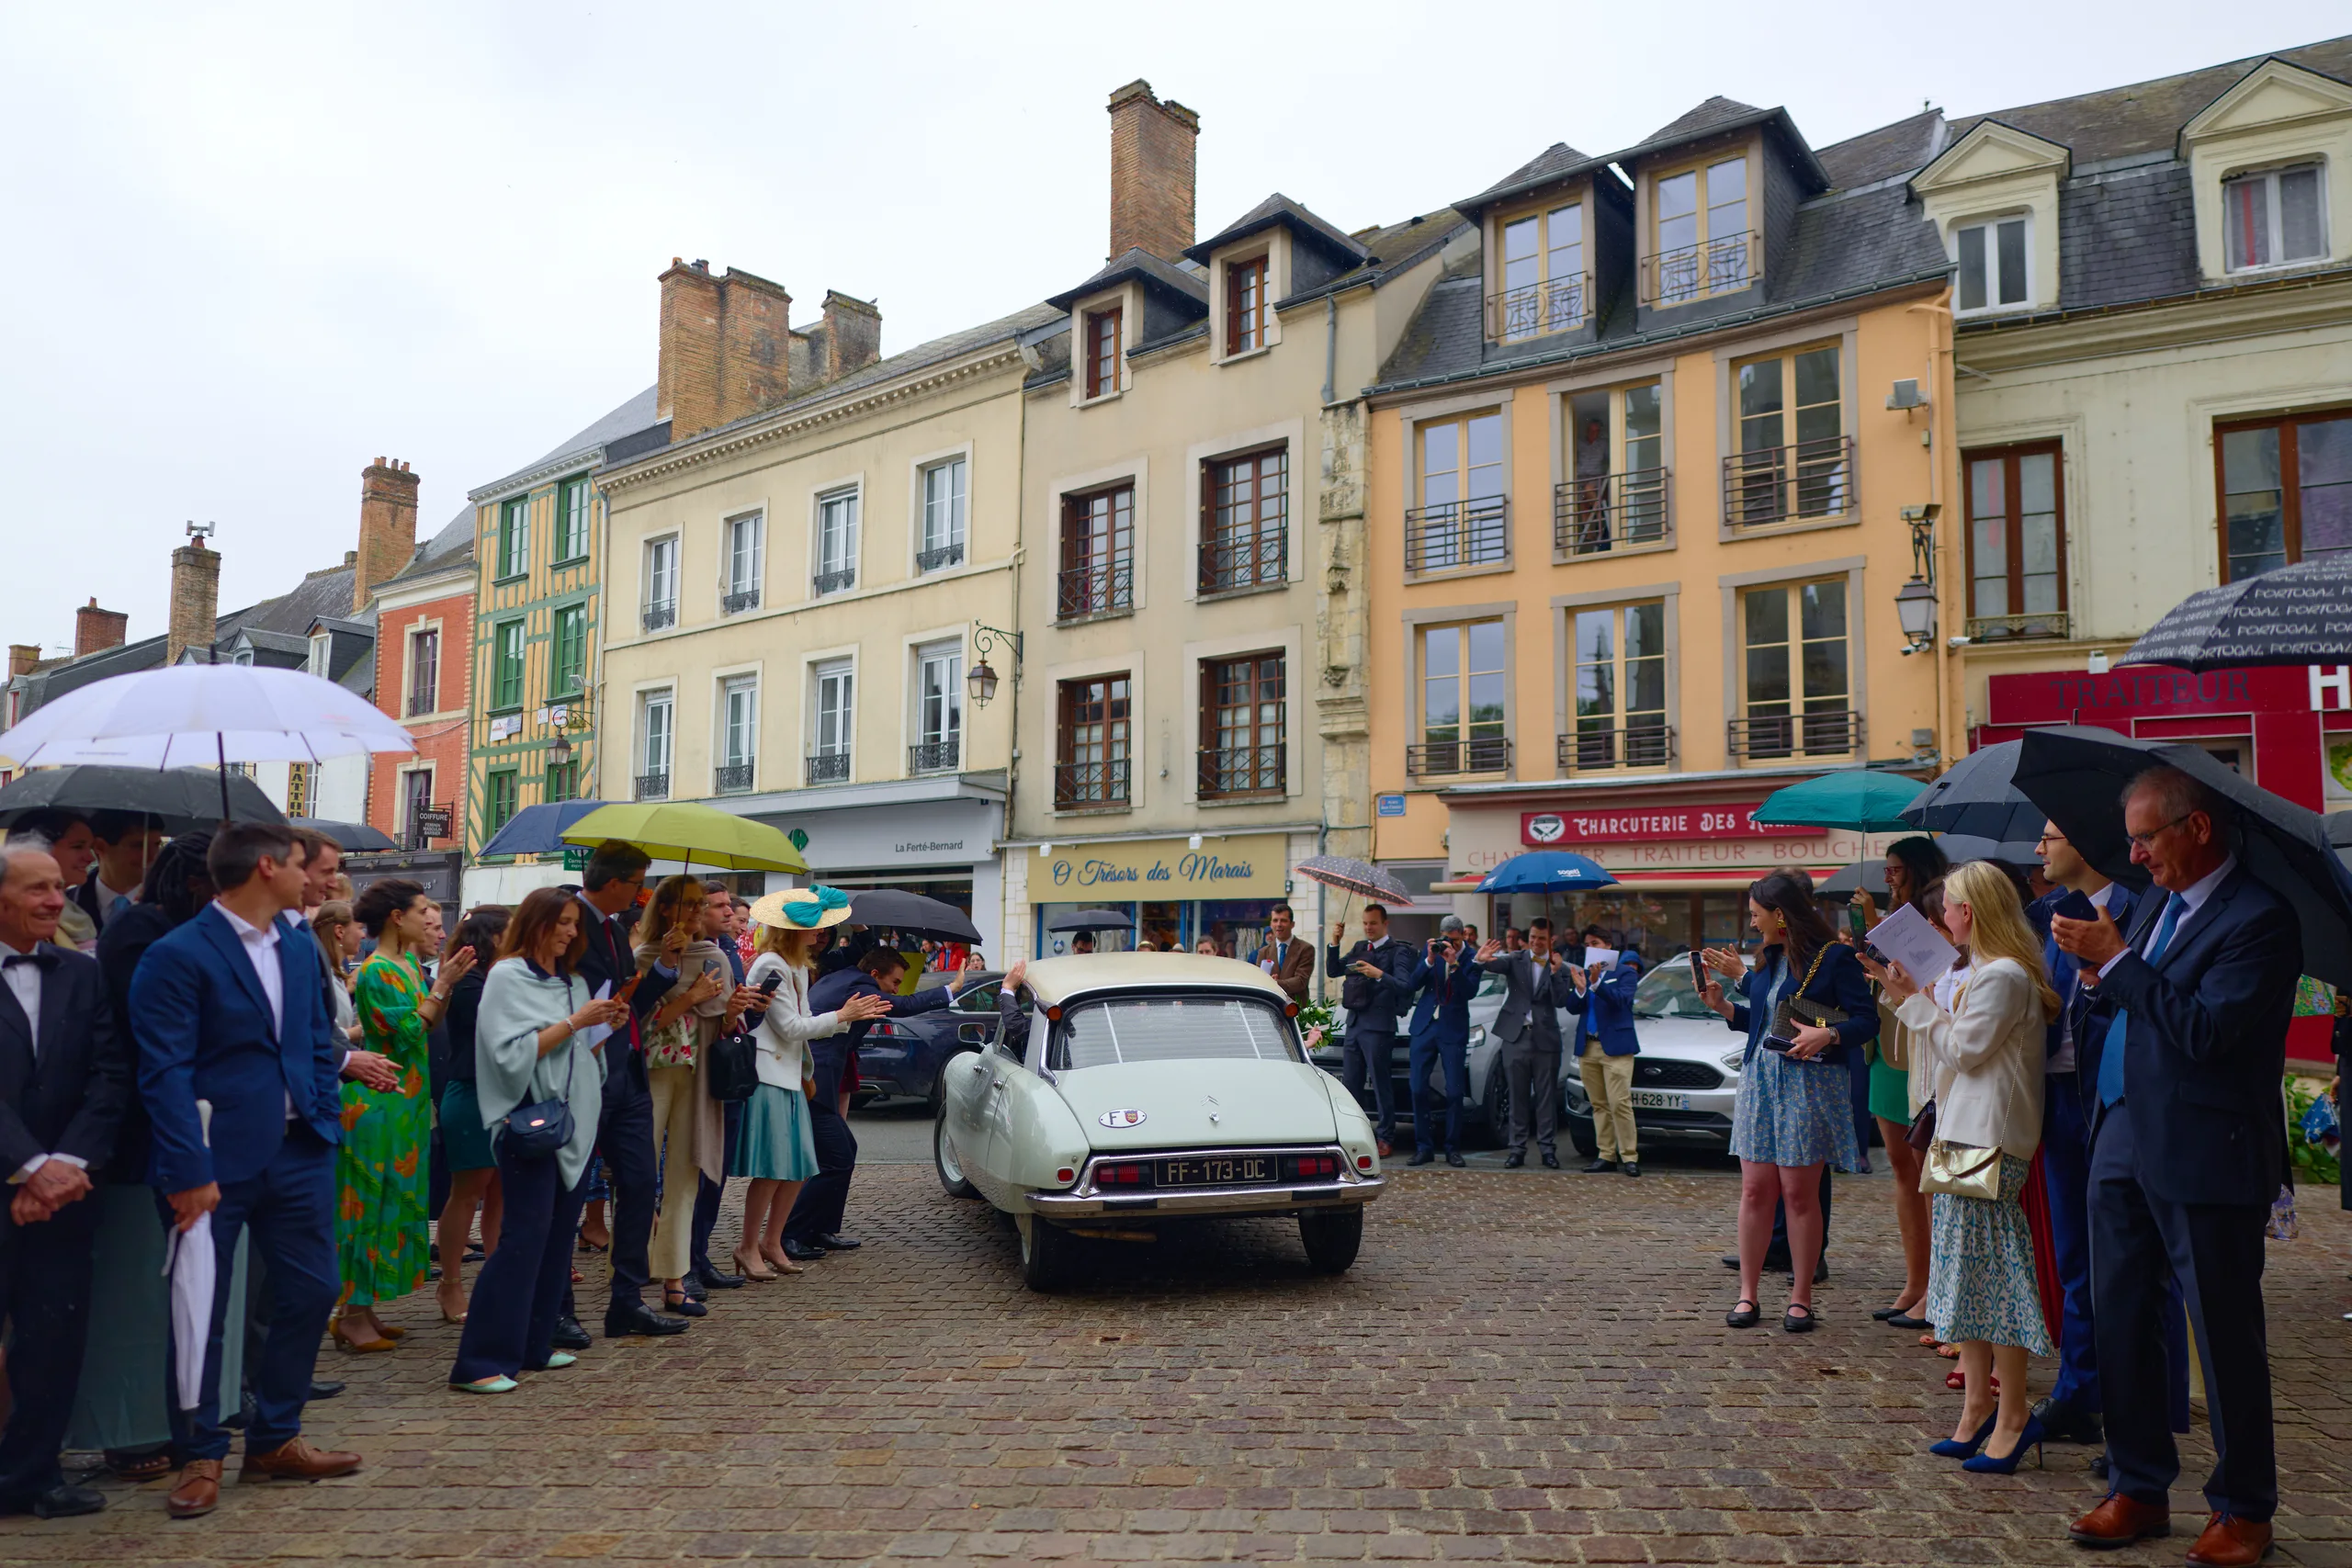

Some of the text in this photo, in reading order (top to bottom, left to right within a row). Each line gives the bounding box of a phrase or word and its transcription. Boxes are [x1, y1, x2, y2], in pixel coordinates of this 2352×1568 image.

[2255, 587, 2335, 600] PORTUGAL
[2237, 623, 2317, 637] PORTUGAL
[2051, 671, 2252, 709] TRAITEUR
[419, 812, 448, 820] COIFFURE
[1573, 815, 1688, 836] CHARCUTERIE
[1701, 813, 1736, 831] DES
[895, 840, 963, 852] La Ferté-Bernard
[1629, 843, 1746, 863] TRAITEUR
[1773, 840, 1896, 859] BOUCHE
[1053, 852, 1254, 886] O Trésors des Marais
[1109, 1111, 1120, 1125] F
